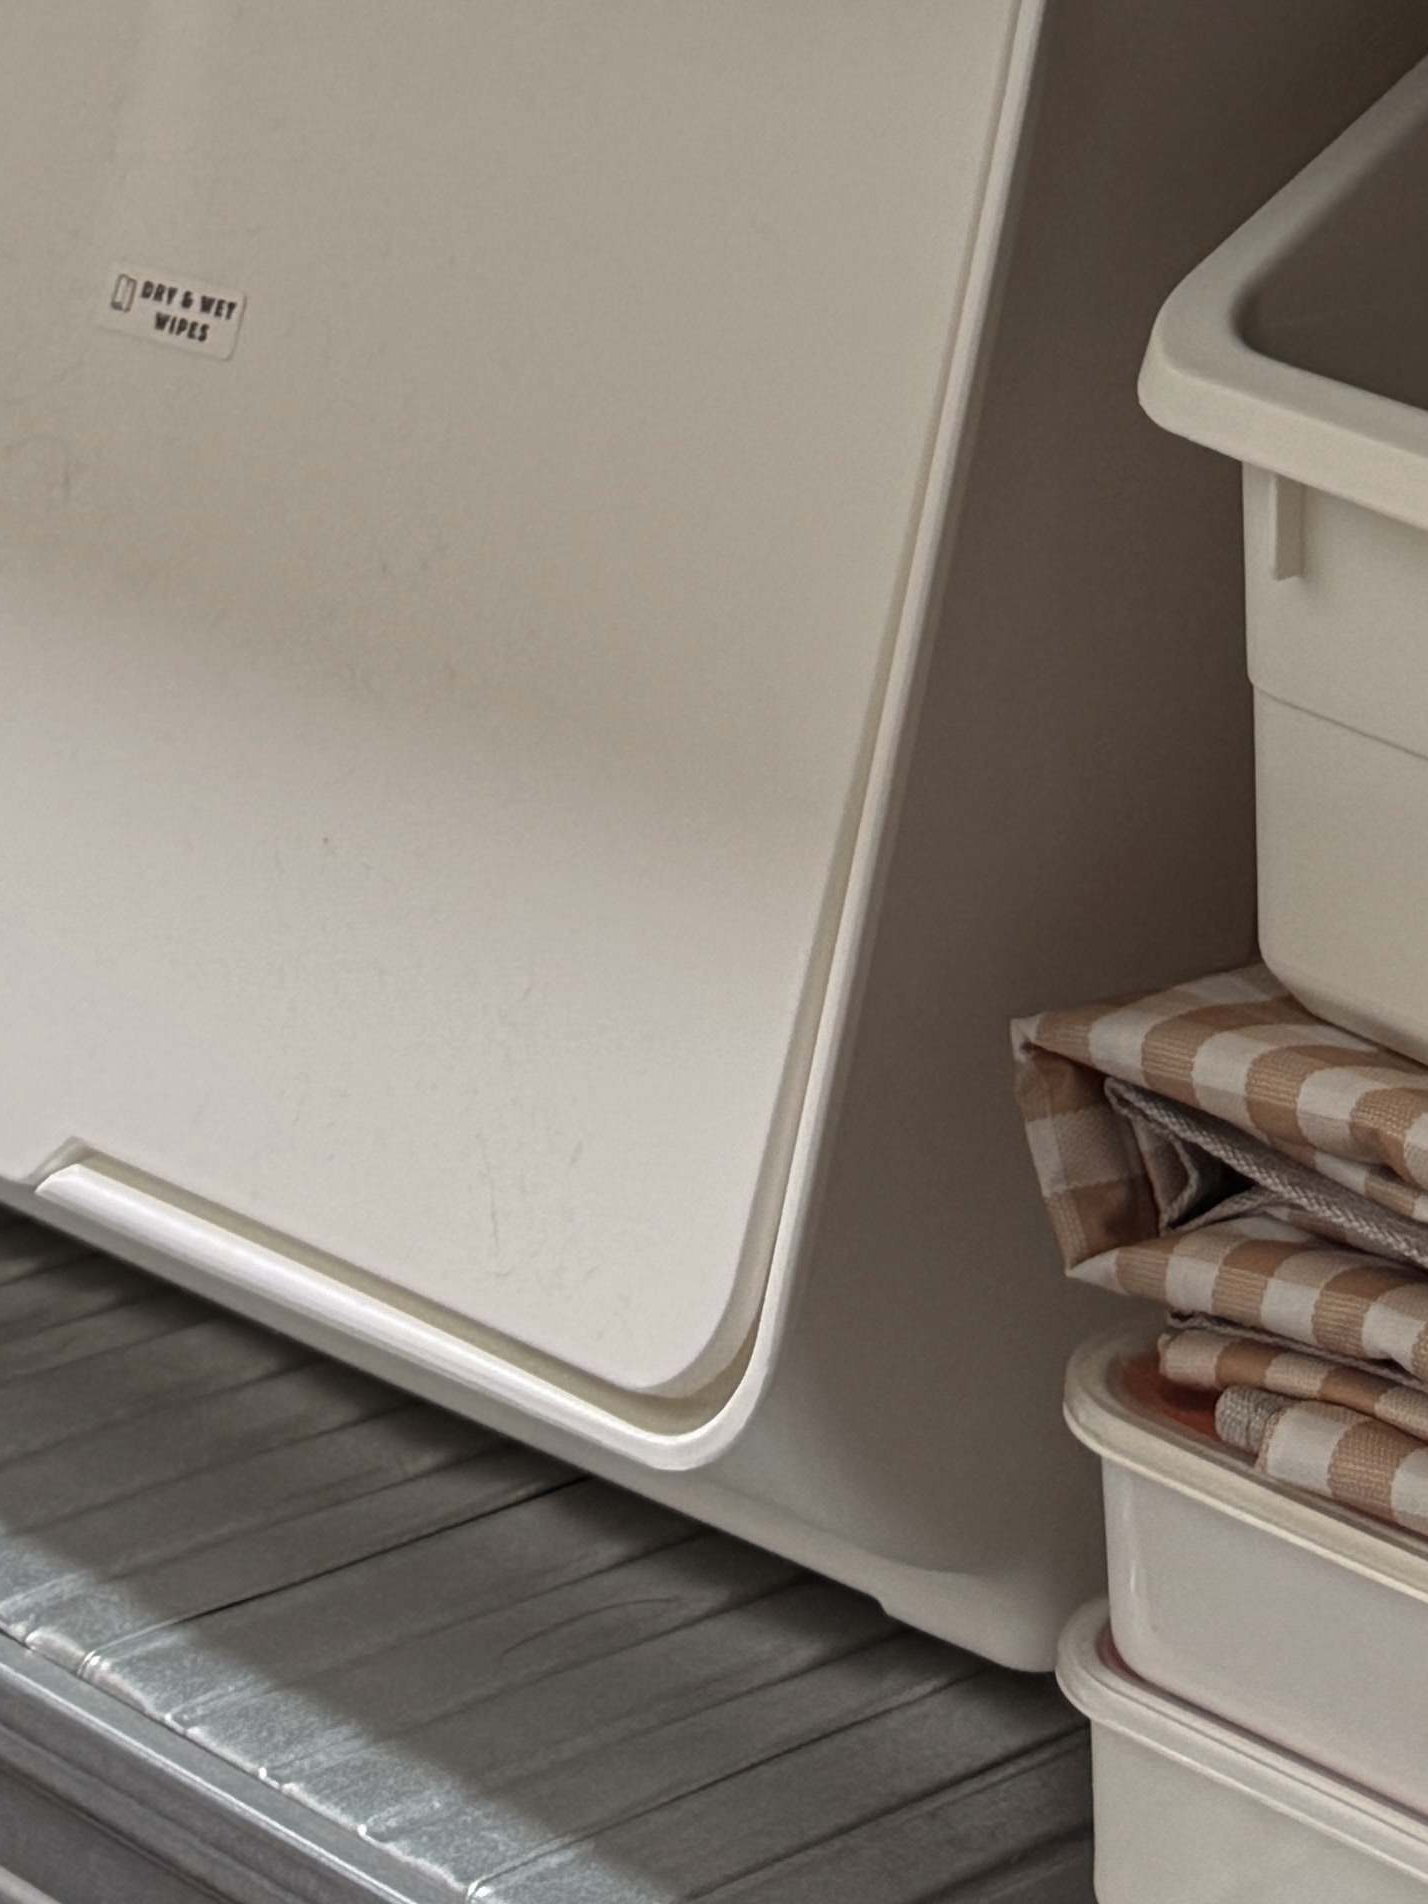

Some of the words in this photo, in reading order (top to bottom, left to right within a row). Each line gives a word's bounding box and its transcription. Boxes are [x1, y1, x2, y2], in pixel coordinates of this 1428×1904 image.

[140, 280, 178, 305] DRY
[181, 290, 194, 309] &
[200, 295, 237, 320] WET
[155, 312, 210, 342] WIPES
